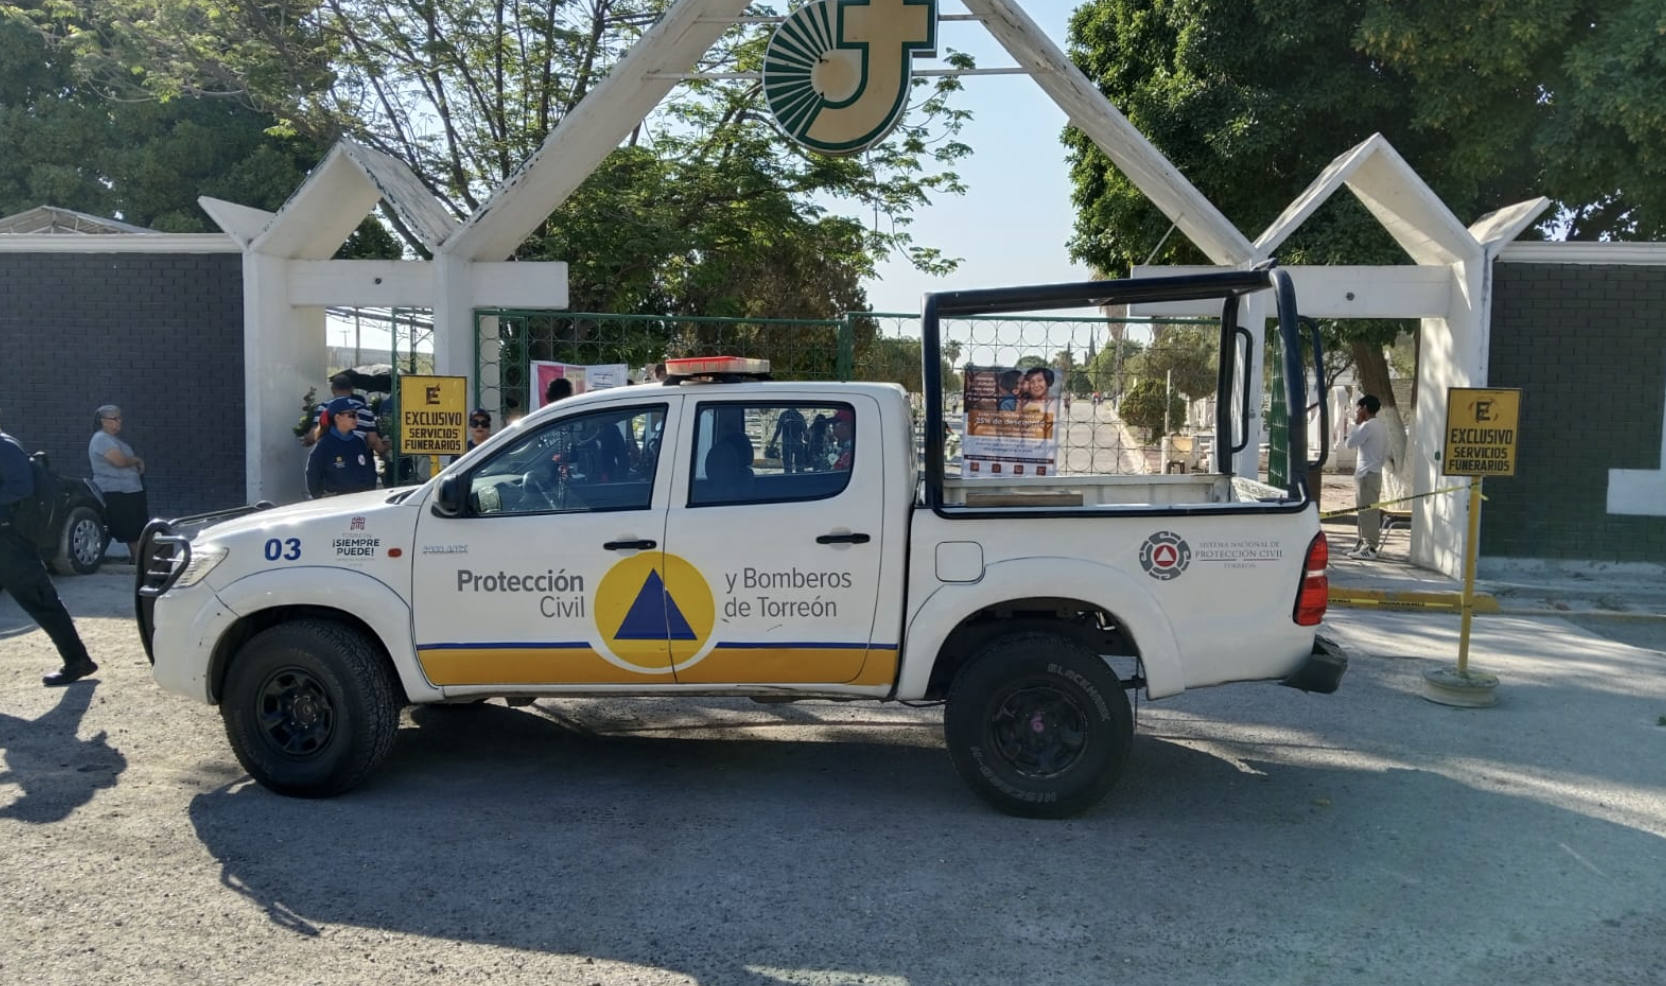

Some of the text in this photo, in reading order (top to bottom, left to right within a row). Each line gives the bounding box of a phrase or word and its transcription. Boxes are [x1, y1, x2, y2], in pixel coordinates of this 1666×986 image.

[405, 411, 462, 426] EXCLUSIVO
[409, 428, 459, 439] SERVICIOS
[1451, 428, 1513, 445] EXCLUSIVO
[405, 439, 461, 451] FUNERARIOS
[1454, 446, 1508, 459] SERVICIOS
[1449, 459, 1510, 472] FUNERARIOS
[264, 538, 301, 561] 03
[332, 538, 381, 548] ¡SIEMPRE
[337, 547, 374, 557] PUEDE!
[1259, 549, 1283, 558] CIVIL
[457, 568, 584, 592] Protección
[725, 567, 852, 594] y Bomberos
[540, 595, 585, 618] Civil
[724, 595, 837, 618] de Torreón
